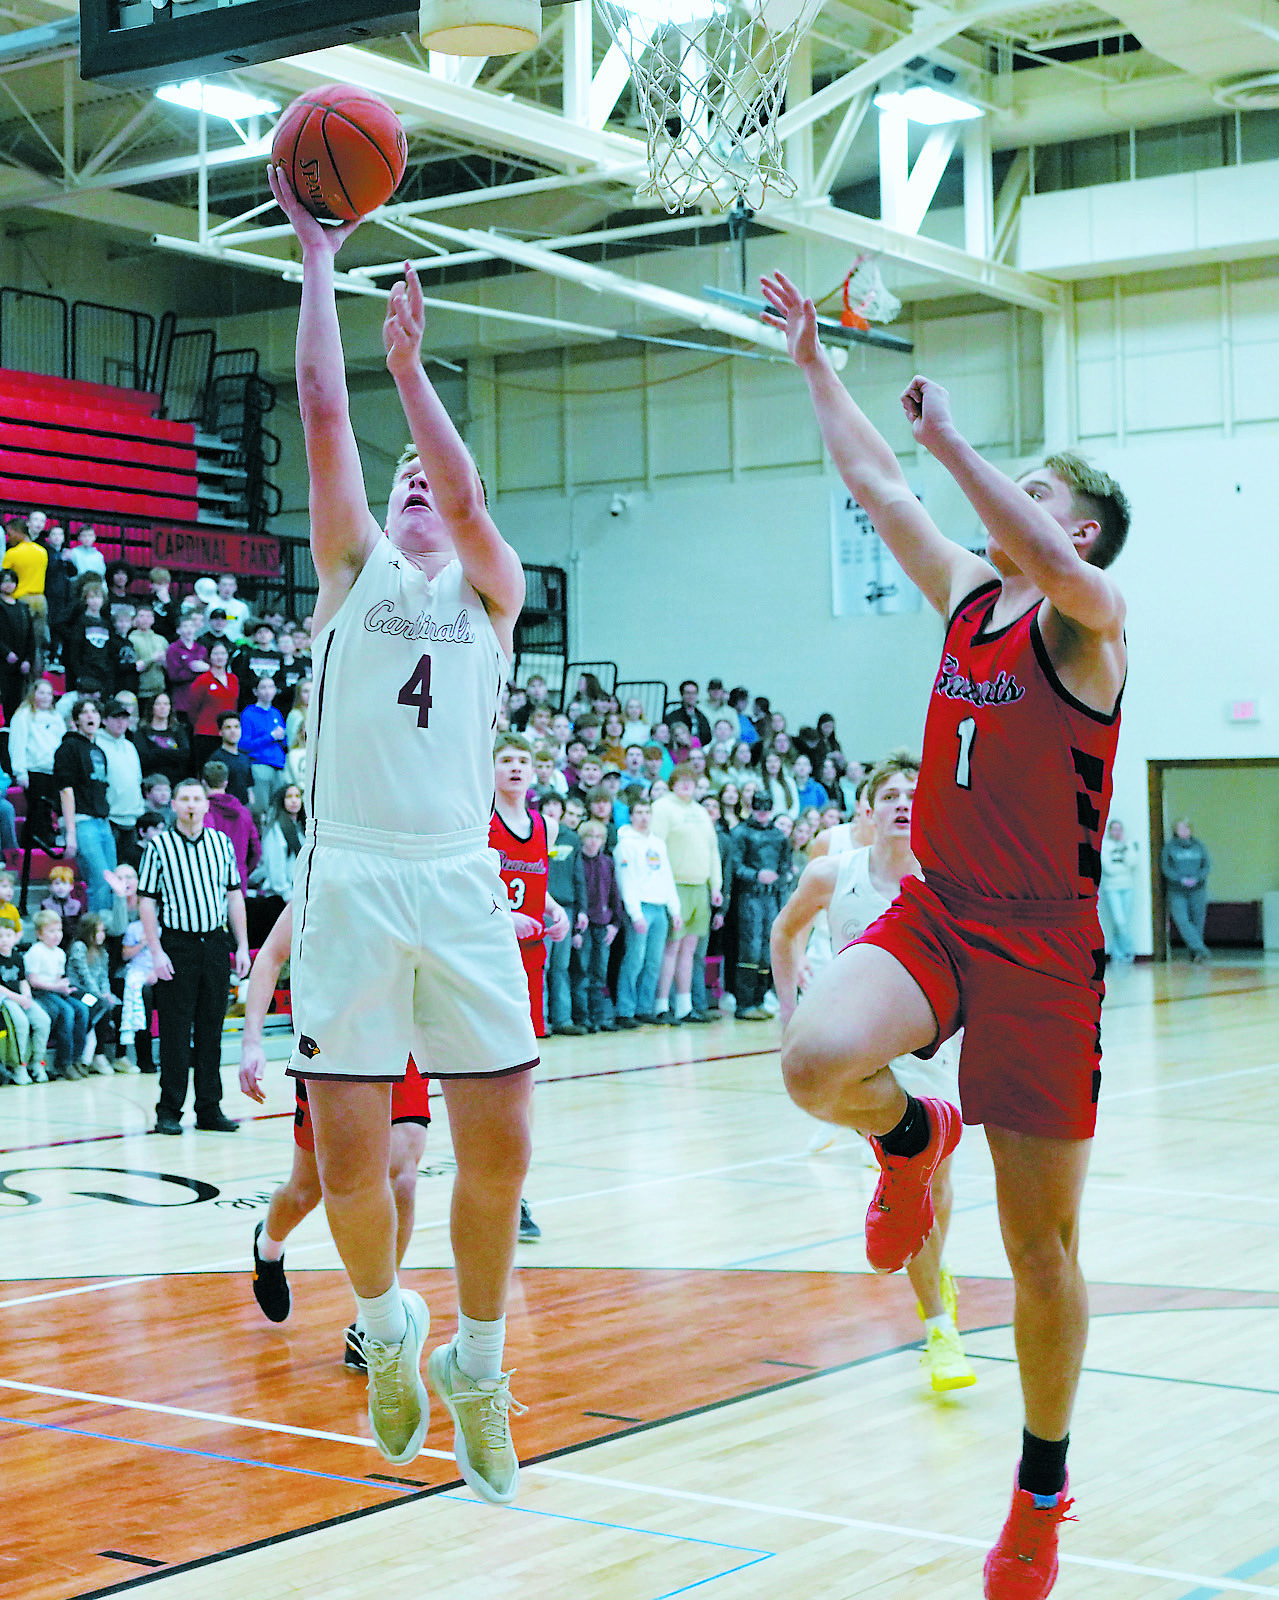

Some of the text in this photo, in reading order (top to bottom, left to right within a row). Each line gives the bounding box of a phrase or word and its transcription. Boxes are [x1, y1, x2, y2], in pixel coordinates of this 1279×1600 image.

[154, 530, 279, 572] CARDINAL FANS
[363, 599, 475, 643] Cardinals
[397, 653, 433, 729] 4
[955, 715, 977, 791] 1
[508, 877, 526, 911] 3
